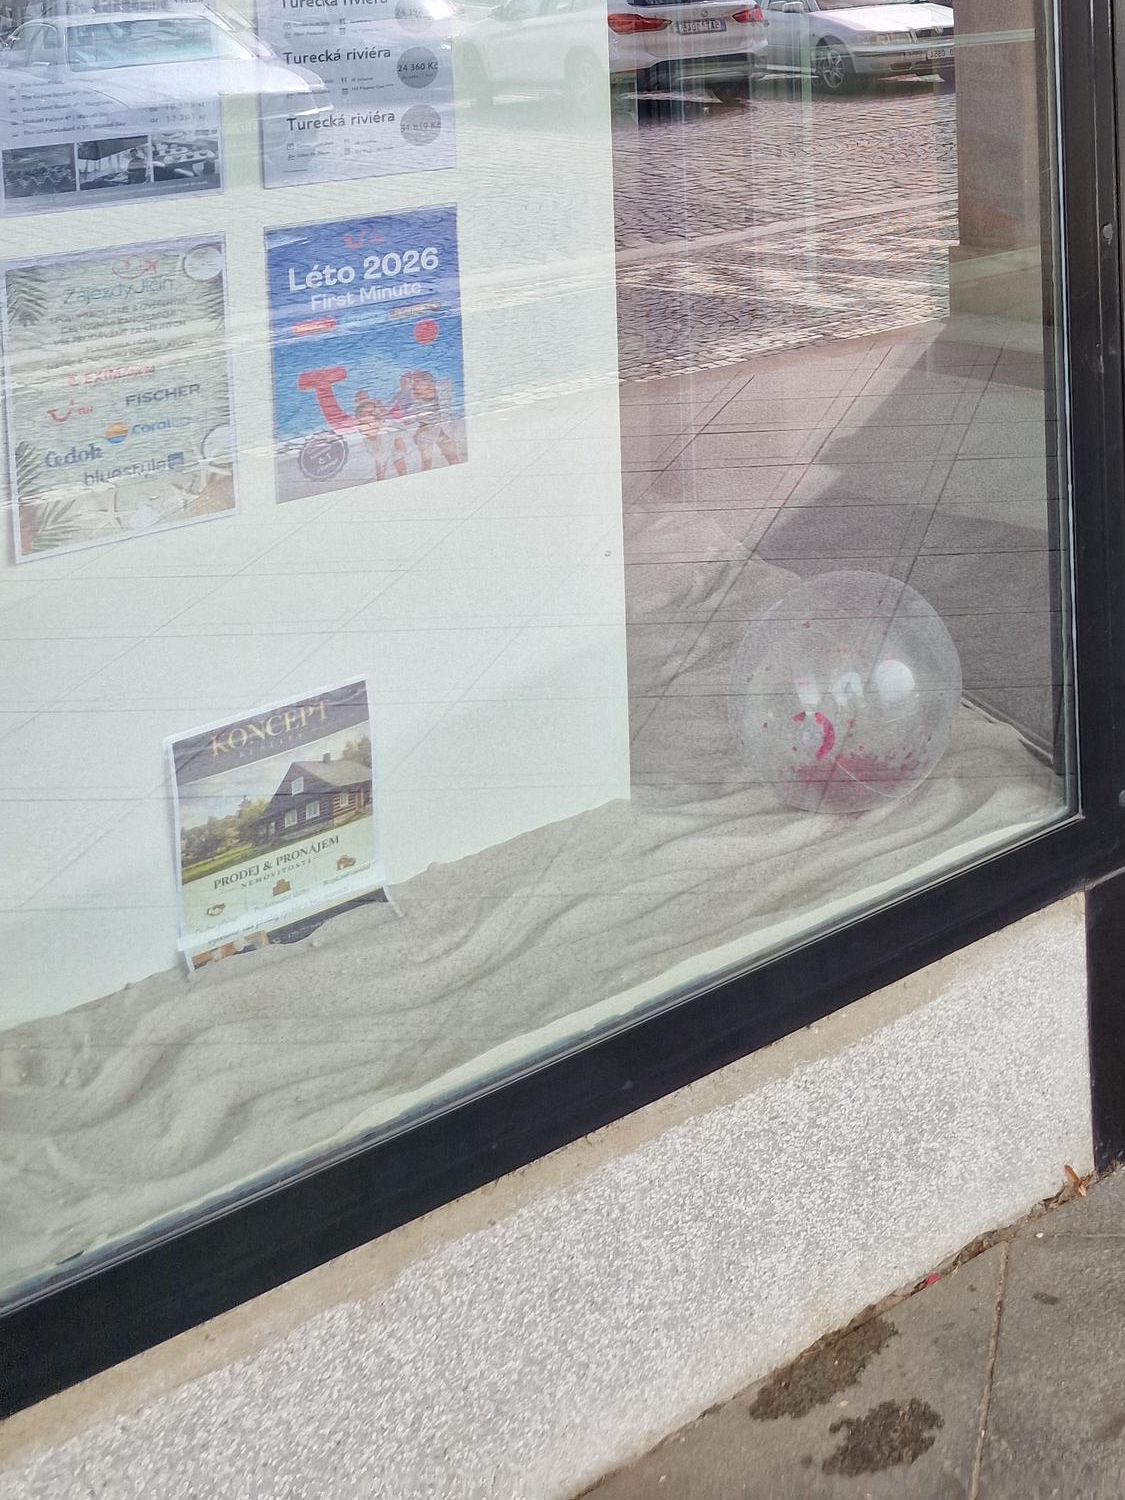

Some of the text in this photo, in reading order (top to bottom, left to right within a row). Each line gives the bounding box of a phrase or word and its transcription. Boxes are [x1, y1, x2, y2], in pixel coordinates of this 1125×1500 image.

[283, 46, 392, 65] Turecká riviéra
[286, 110, 395, 131] Turecká riviéra
[288, 247, 439, 292] Léto 2026
[311, 281, 422, 311] First Minute
[125, 383, 200, 407] FISCHER
[210, 698, 329, 757] KONCEPT
[213, 834, 340, 890] PRODEJ & PRONÁJEM
